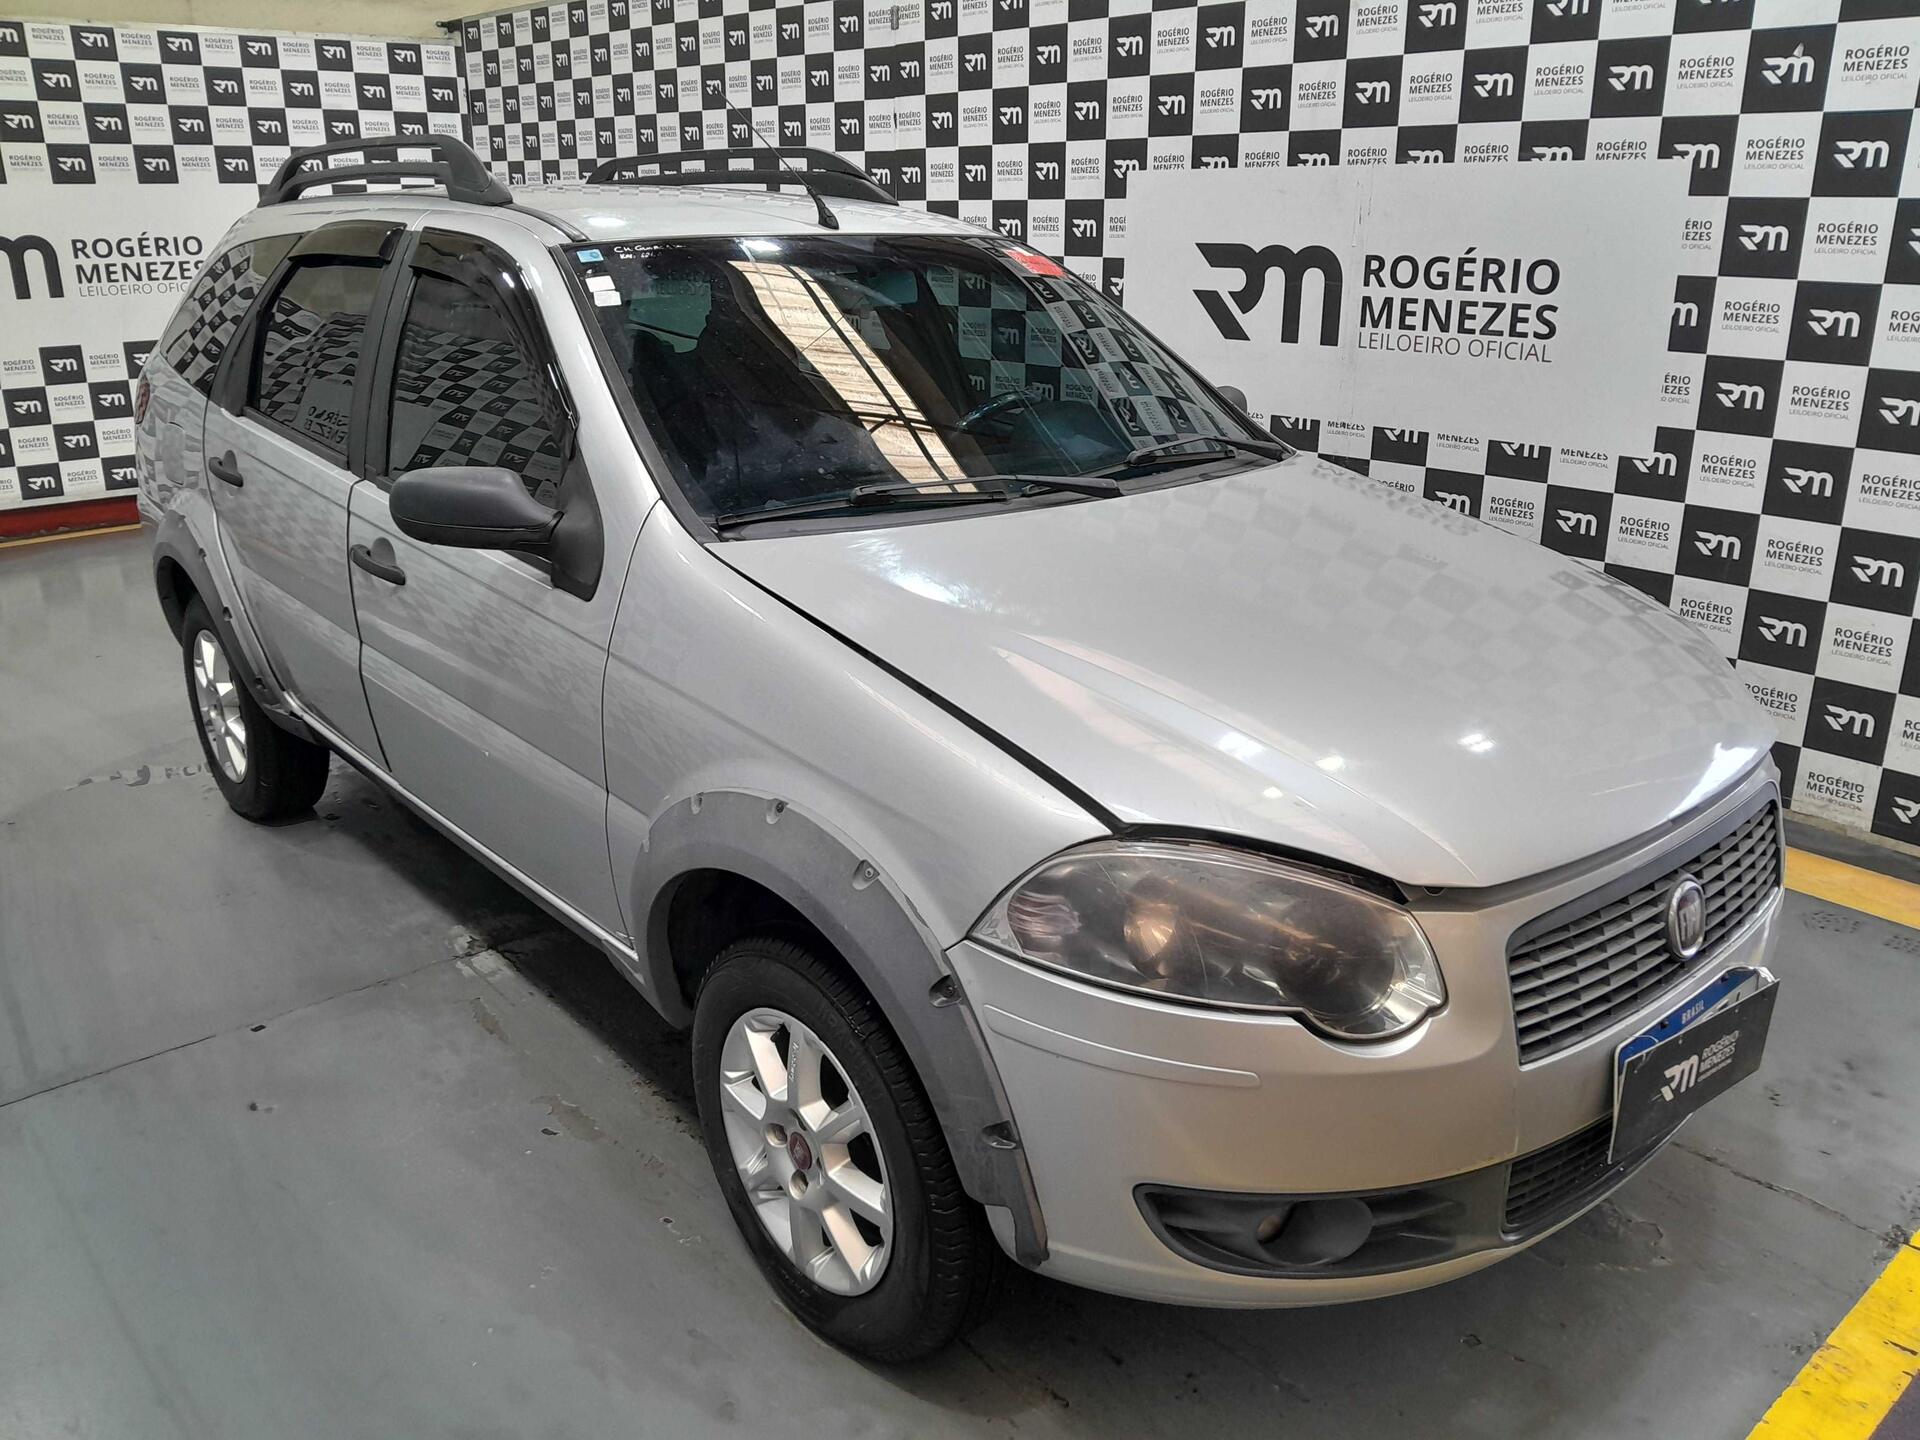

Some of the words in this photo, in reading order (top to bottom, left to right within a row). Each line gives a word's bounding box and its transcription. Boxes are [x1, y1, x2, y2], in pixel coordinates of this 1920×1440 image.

[1357, 4, 1398, 17] ROGÉRIO
[1477, 3, 1524, 16] MENEZES
[1251, 16, 1287, 28] ROGÉRIO
[1356, 15, 1398, 27] MENEZES
[1157, 27, 1189, 38] ROGÉRIO
[1251, 26, 1287, 37] MENEZES
[1073, 37, 1102, 47] ROGÉRIO
[1157, 36, 1189, 47] MENEZES
[997, 46, 1024, 55] ROGÉRIO
[1073, 45, 1102, 55] MENEZES
[1845, 45, 1910, 60] ROGÉRIO
[929, 54, 953, 63] ROGÉRIO
[997, 54, 1024, 63] MENEZES
[1679, 55, 1734, 69] ROGÉRIO
[929, 61, 953, 70] MENEZES
[1536, 64, 1584, 76] ROGÉRIO
[1843, 58, 1908, 72] MENEZES
[1409, 72, 1452, 84] ROGÉRIO
[1678, 68, 1733, 80] MENEZES
[1298, 80, 1336, 91] ROGÉRIO
[1534, 76, 1583, 87] MENEZES
[1200, 88, 1234, 98] ROGÉRIO
[1409, 83, 1452, 94] MENEZES
[1112, 95, 1143, 104] ROGÉRIO
[1200, 97, 1234, 107] MENEZES
[1298, 91, 1336, 101] MENEZES
[962, 106, 987, 115] ROGÉRIO
[1033, 100, 1061, 110] ROGÉRIO
[1112, 104, 1143, 112] MENEZES
[962, 114, 987, 122] MENEZES
[1033, 109, 1061, 118] MENEZES
[1596, 139, 1647, 153] ROGÉRIO
[1747, 136, 1805, 149] ROGÉRIO
[1464, 142, 1509, 156] ROGÉRIO
[1745, 150, 1804, 160] MENEZES
[9, 154, 42, 163] ROGÉRIO
[10, 160, 43, 168] MENEZES
[1071, 157, 1099, 166] ROGÉRIO
[1071, 166, 1099, 174] MENEZES
[1032, 215, 1059, 224] ROGÉRIO
[1032, 224, 1059, 232] MENEZES
[1817, 221, 1878, 234] ROGÉRIO
[71, 232, 203, 259] ROGÉRIO
[1815, 235, 1877, 246] MENEZES
[1362, 247, 1560, 295] ROGÉRIO
[79, 283, 153, 297] LEILOEIRO
[157, 282, 188, 293] OFIC
[1724, 300, 1780, 313] ROGÉRIO
[1359, 295, 1559, 340] MENEZES
[1723, 312, 1779, 324] MENEZES
[1358, 332, 1461, 356] LEILOEIRO
[1467, 339, 1553, 363] OFICIAL
[1792, 386, 1850, 400] ROGÉRIO
[1790, 397, 1849, 411] MENEZES
[1702, 454, 1756, 469] ROGÉRIO
[1700, 464, 1755, 479] MENEZES
[1490, 497, 1535, 511] ROGÉRIO
[1489, 506, 1534, 520] MENEZES
[1620, 516, 1670, 531] ROGÉRIO
[1619, 526, 1669, 541] MENEZES
[1767, 539, 1824, 556] ROGÉRIO
[1766, 549, 1823, 567] MENEZES
[1680, 598, 1733, 615] ROGÉRIO
[1679, 608, 1732, 626] MENEZES
[1835, 627, 1893, 646] ROGÉRIO
[1833, 638, 1892, 657] MENEZES
[1808, 771, 1864, 793] ROGÉRIO
[1806, 781, 1864, 803] MENEZES
[1682, 1000, 1704, 1024] BRASIL
